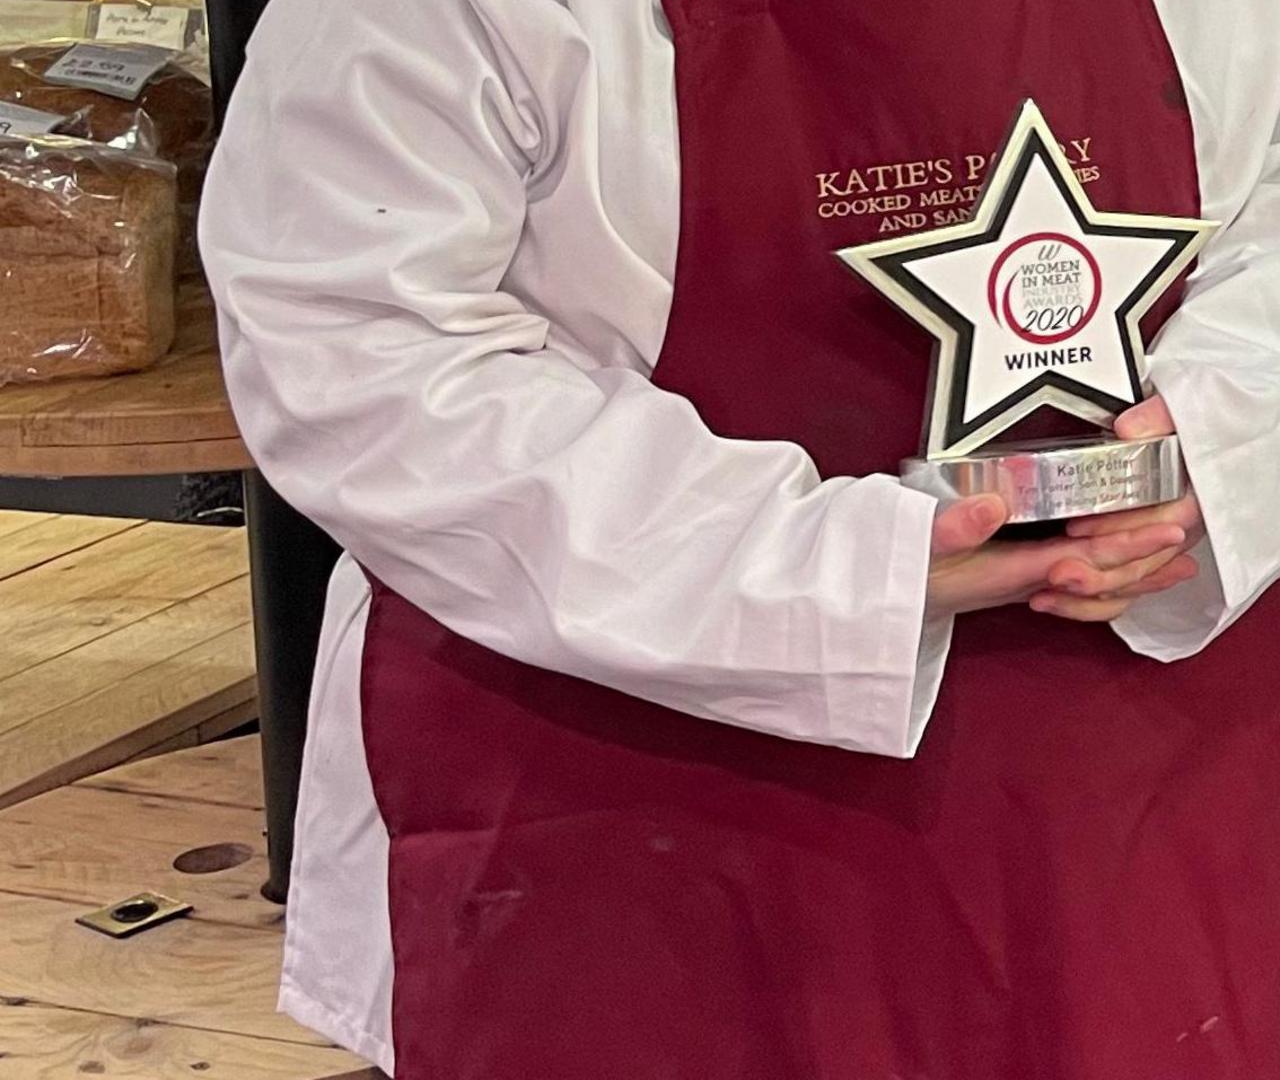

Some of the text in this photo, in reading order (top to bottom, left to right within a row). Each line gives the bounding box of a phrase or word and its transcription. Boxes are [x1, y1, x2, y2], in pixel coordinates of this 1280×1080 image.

[815, 159, 953, 198] KATIE'S
[818, 184, 985, 218] COOKED MEAT
[879, 212, 927, 233] AND
[1021, 260, 1080, 275] WOMEN
[1022, 272, 1081, 288] IN MEAT
[1023, 295, 1083, 310] AWARDS
[1022, 305, 1084, 333] 2020
[1004, 346, 1092, 371] WINNER
[1057, 457, 1134, 476] Katie Potter
